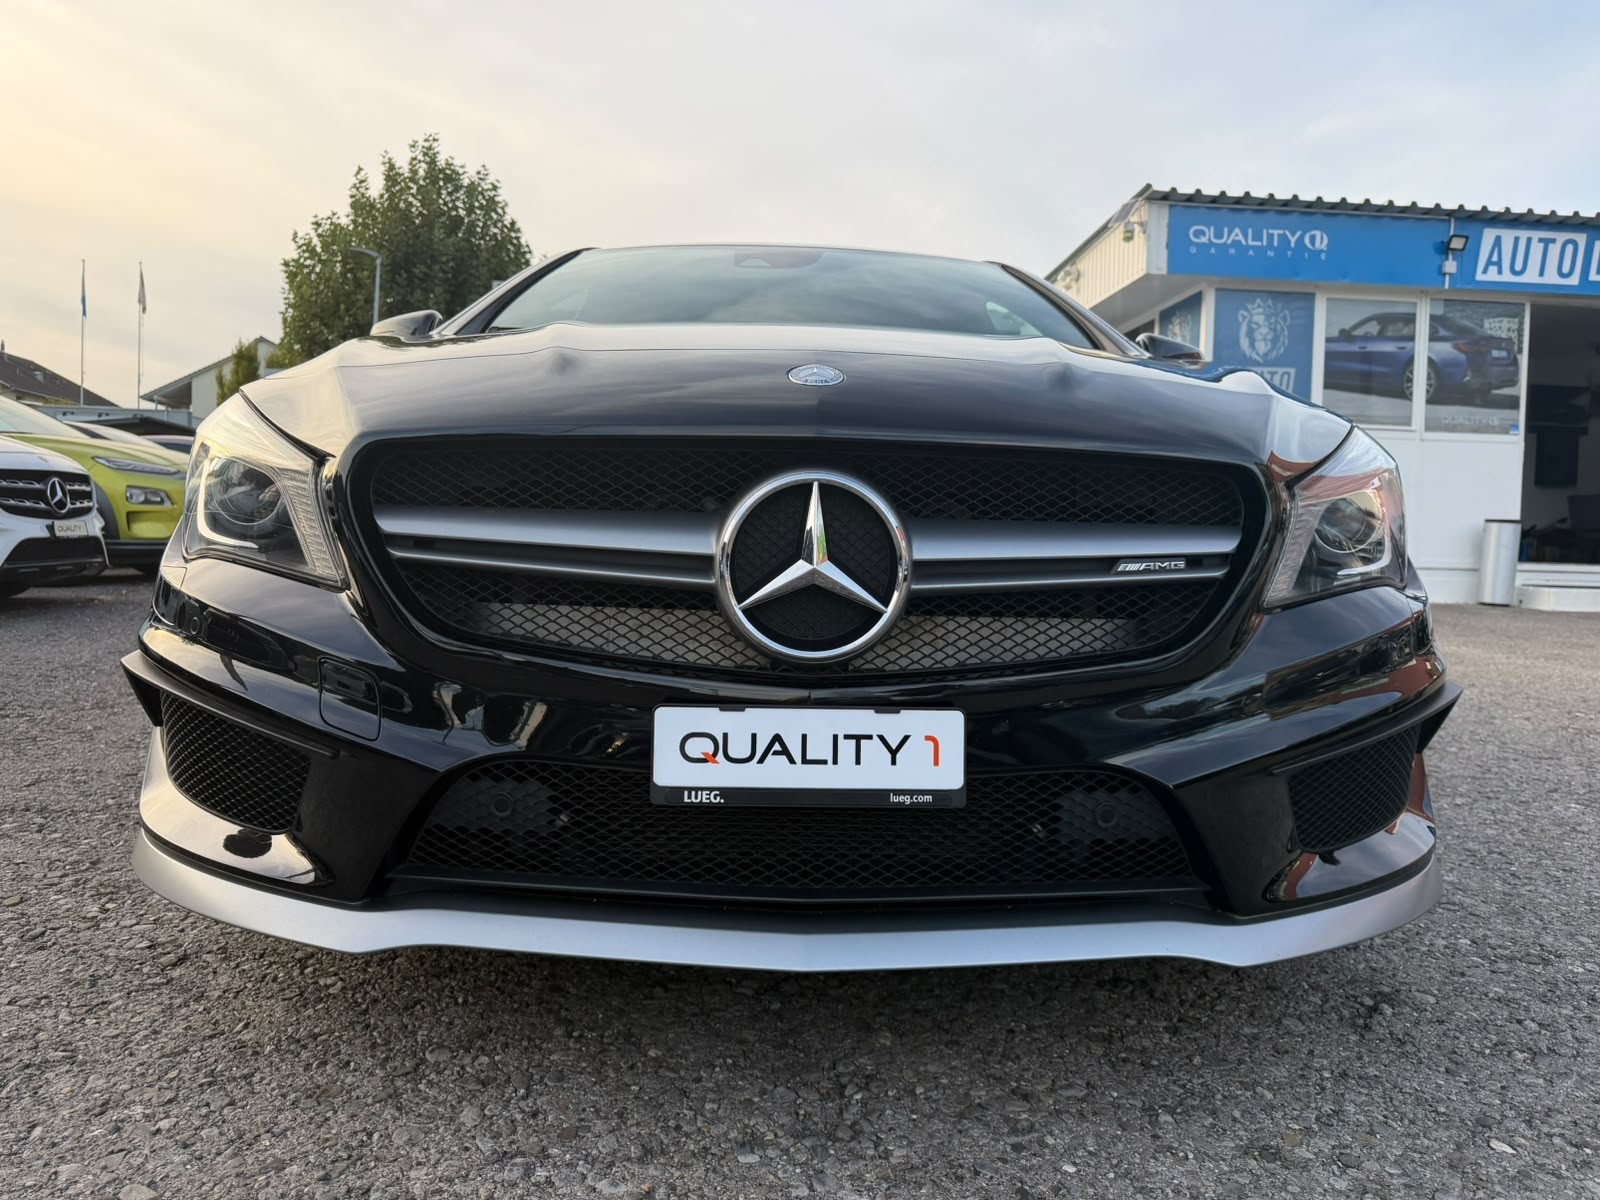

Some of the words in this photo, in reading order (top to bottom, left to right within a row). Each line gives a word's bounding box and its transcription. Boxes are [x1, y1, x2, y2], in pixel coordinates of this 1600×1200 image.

[1188, 225, 1302, 248] QUALITY
[1189, 246, 1327, 261] GARANTIE
[1481, 234, 1579, 279] AUTO
[679, 731, 911, 766] QUALITY
[924, 735, 940, 767] 1
[683, 790, 725, 803] LUEG.
[890, 793, 933, 804] lueg.com
